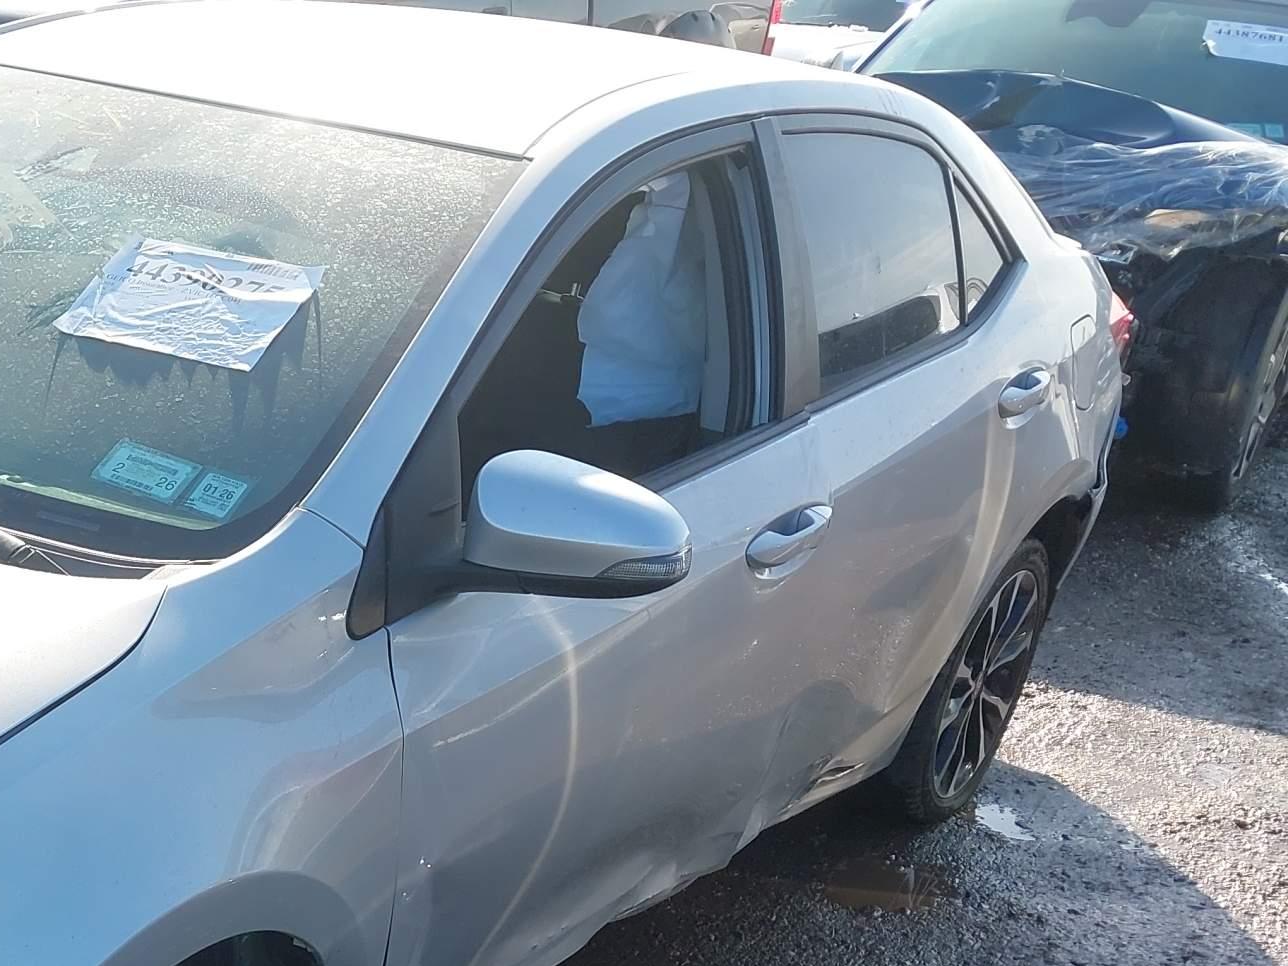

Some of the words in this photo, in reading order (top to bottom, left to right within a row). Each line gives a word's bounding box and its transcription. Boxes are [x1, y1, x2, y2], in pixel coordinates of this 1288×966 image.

[111, 462, 126, 474] 2
[154, 476, 178, 491] 26
[202, 483, 218, 496] 01
[218, 488, 236, 501] 26
